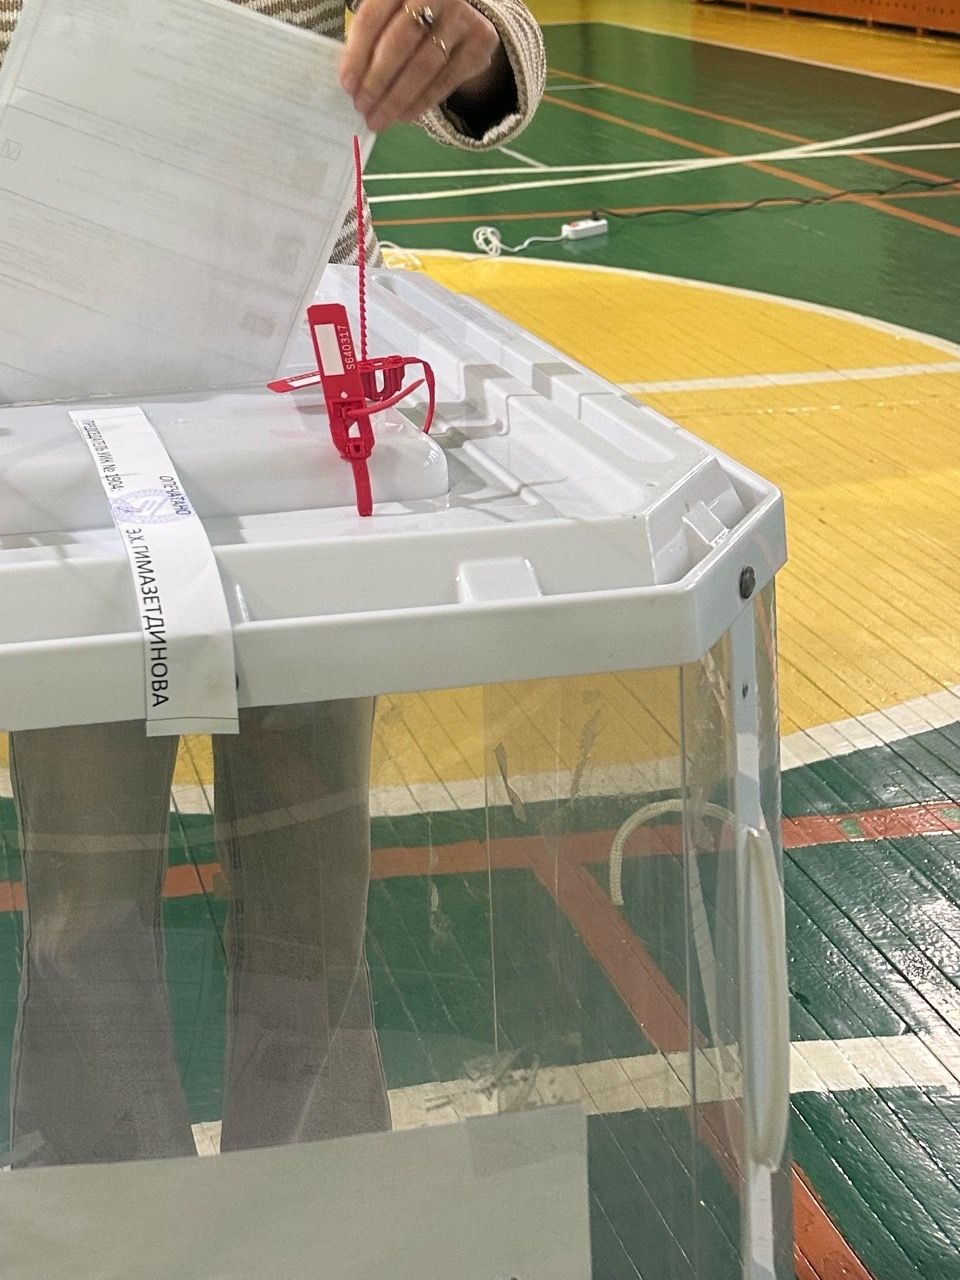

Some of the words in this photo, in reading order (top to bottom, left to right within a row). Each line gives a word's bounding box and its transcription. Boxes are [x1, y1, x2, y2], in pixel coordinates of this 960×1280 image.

[338, 324, 355, 370] S640317
[159, 475, 192, 516] ОПЕЧАТАНО
[131, 545, 170, 708] ГИМАЗЕТДИНОВА
